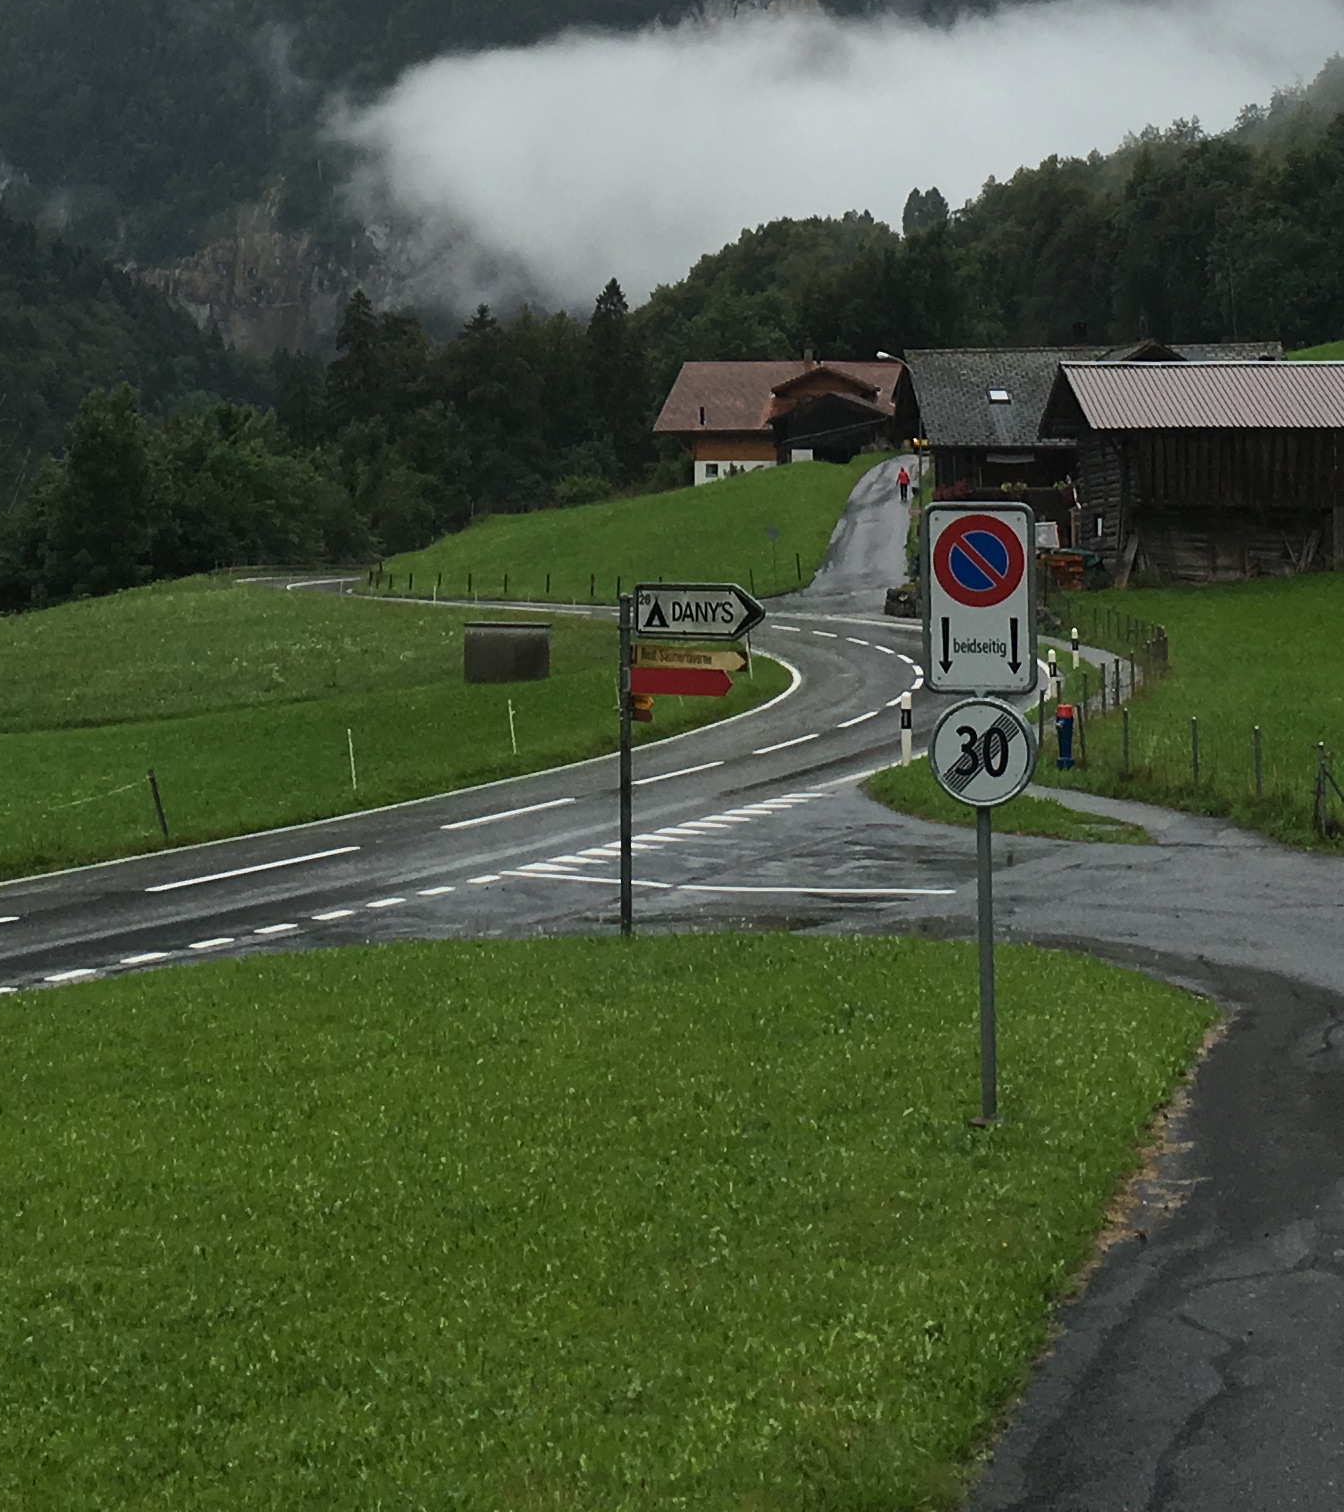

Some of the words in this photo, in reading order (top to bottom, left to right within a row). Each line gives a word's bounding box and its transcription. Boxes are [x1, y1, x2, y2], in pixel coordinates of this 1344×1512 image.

[672, 601, 734, 624] DANY'S
[953, 637, 1007, 657] beidseitig
[955, 725, 1009, 777] 30
